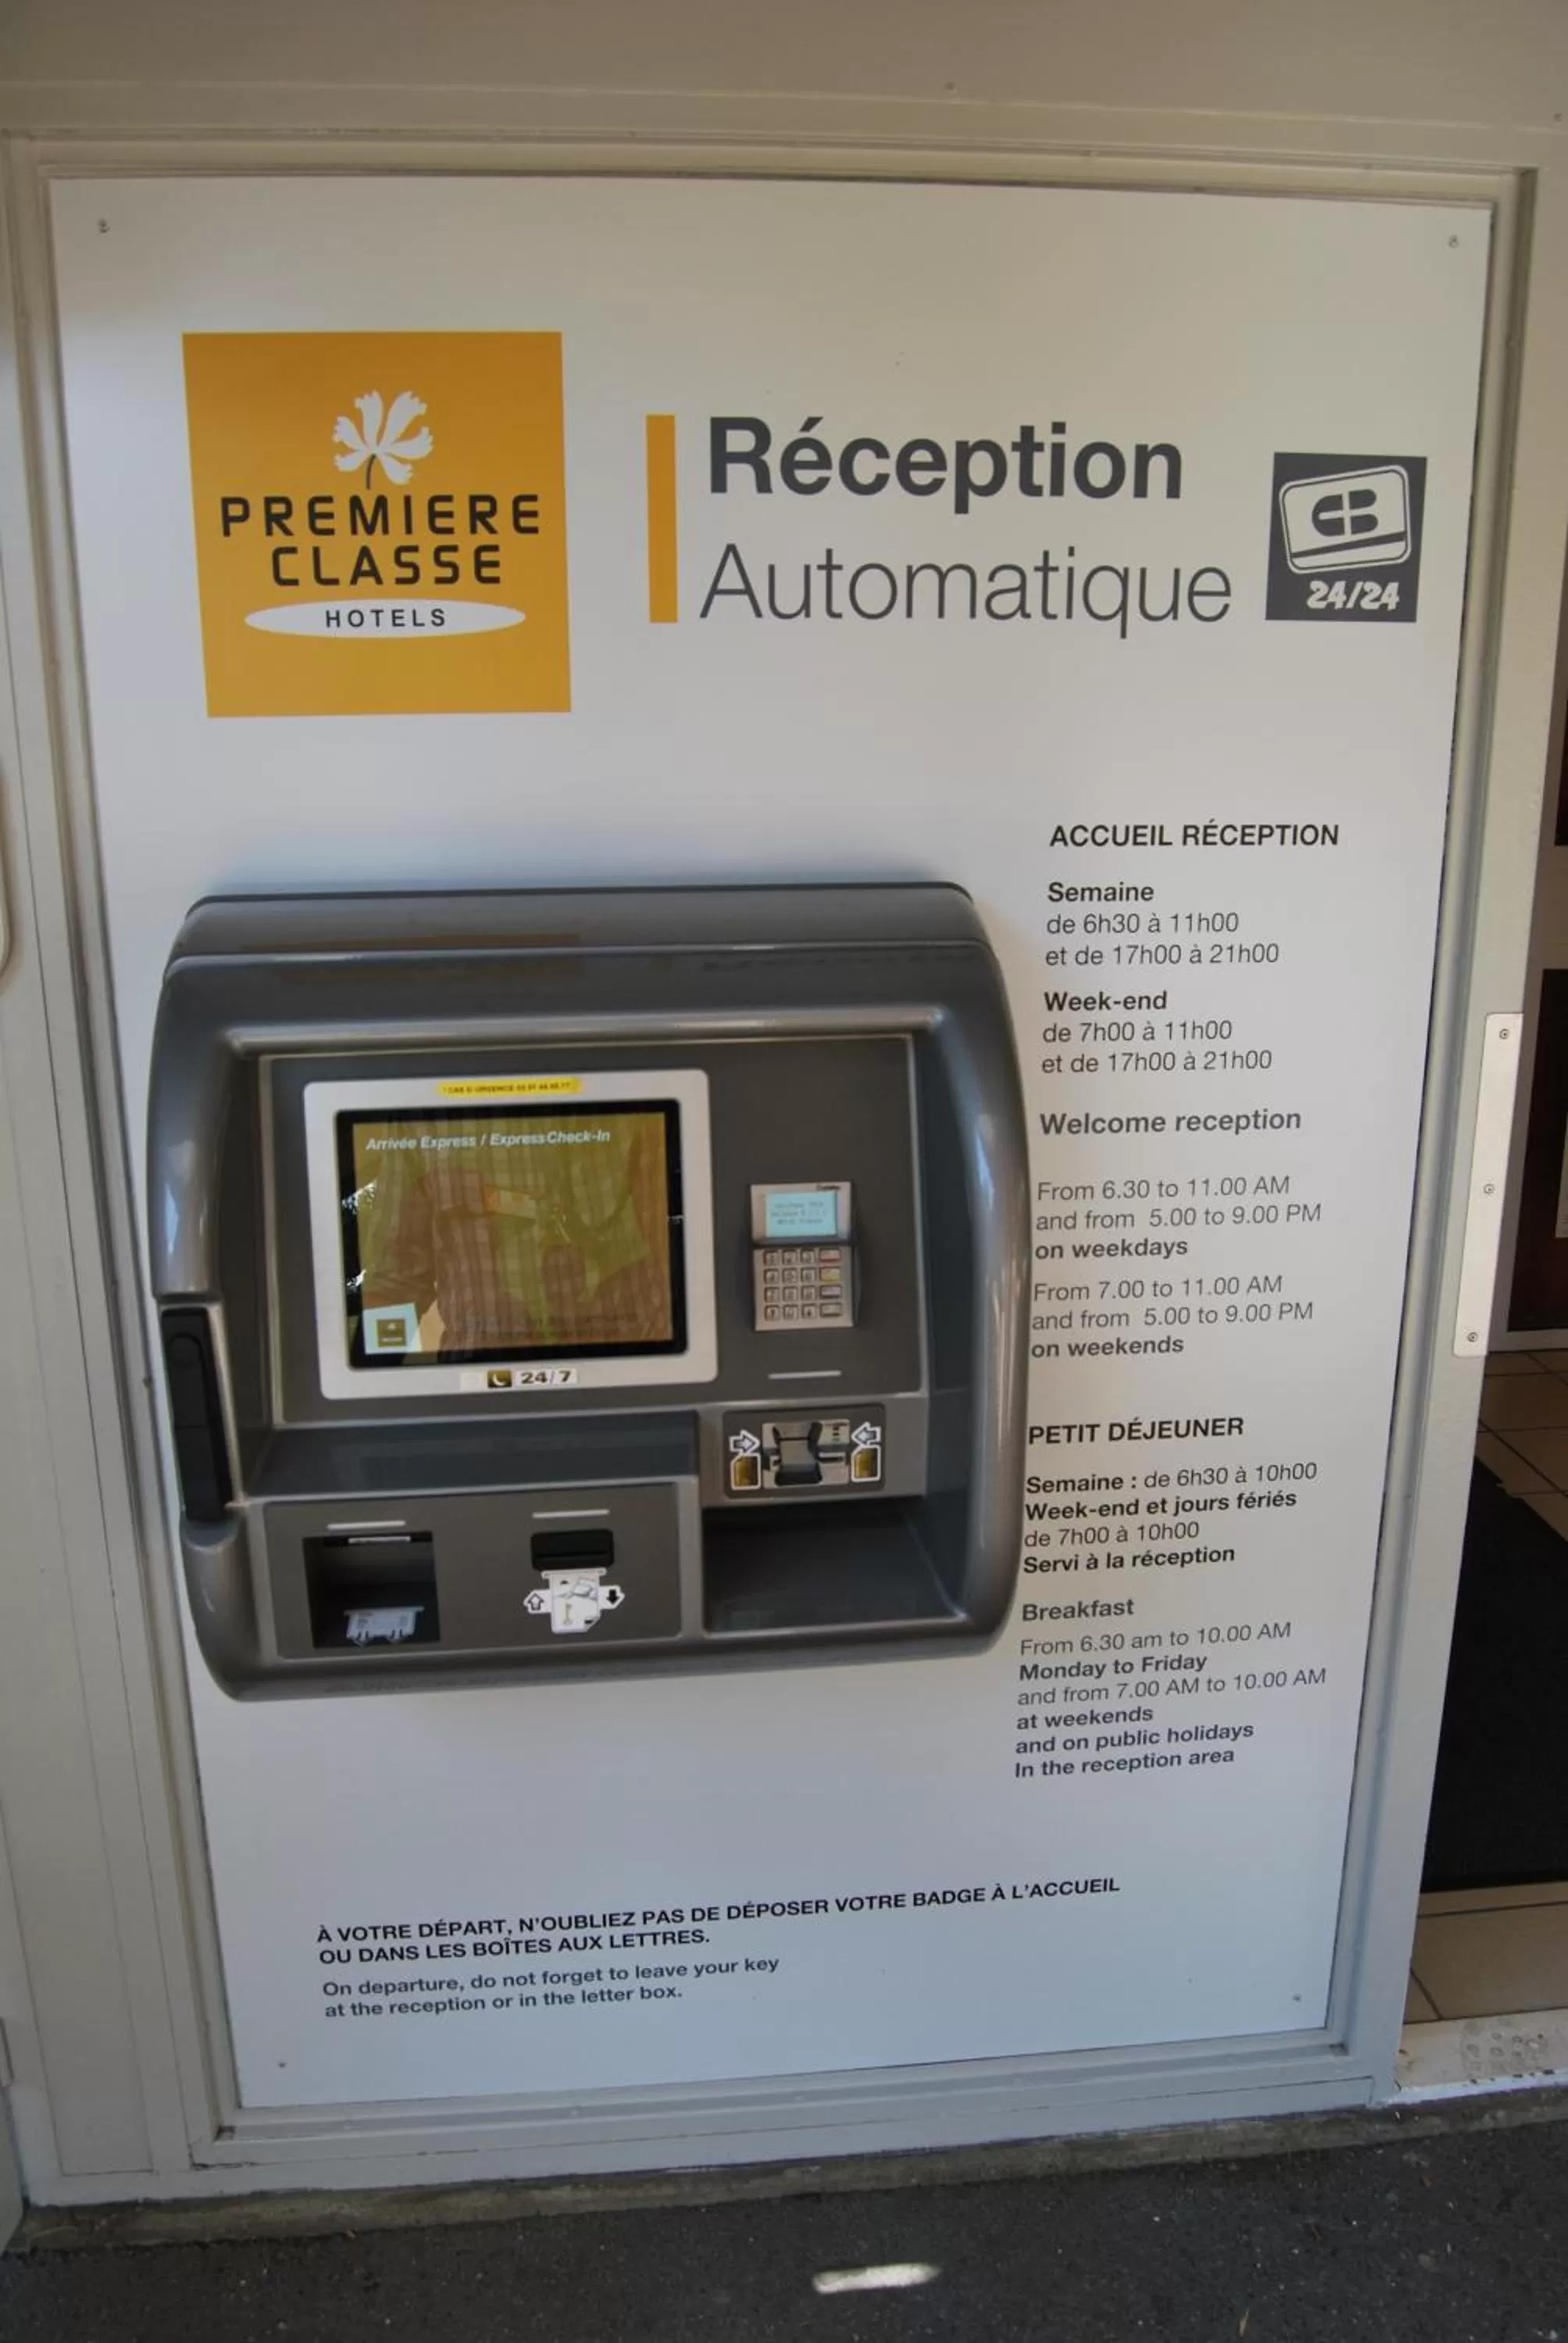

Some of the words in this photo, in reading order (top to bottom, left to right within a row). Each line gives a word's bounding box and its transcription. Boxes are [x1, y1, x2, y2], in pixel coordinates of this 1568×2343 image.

[710, 416, 1183, 514] Réception
[221, 494, 539, 537] PREMIERE
[272, 544, 501, 587] CLASSE
[700, 544, 1232, 639] Automatique
[1306, 580, 1399, 611] 24/24
[326, 608, 446, 628] HOTELS
[1049, 825, 1173, 847] ACCUEIL
[1182, 818, 1338, 846] RÉCEPTION
[1048, 882, 1154, 902] Semaine
[1046, 914, 1075, 934] de
[1083, 914, 1140, 933] 6h30
[1148, 913, 1160, 933] à
[1171, 912, 1238, 933] 11h00
[1046, 947, 1066, 965] et
[1075, 945, 1103, 965] de
[1114, 944, 1181, 965] 17h00
[1189, 944, 1202, 963] à
[1210, 943, 1279, 963] 21h00
[1044, 991, 1167, 1011] Week-end
[1042, 1023, 1071, 1043] de
[1080, 1022, 1135, 1042] 7h00
[1142, 1021, 1155, 1040] à
[1166, 1020, 1232, 1040] 11h00
[1042, 1055, 1062, 1073] et
[1071, 1053, 1099, 1072] de
[1109, 1051, 1176, 1072] 17h00
[1183, 1051, 1196, 1071] à
[1203, 1050, 1272, 1070] 21h00
[1040, 1113, 1166, 1135] Welcome
[1175, 1109, 1301, 1135] reception
[420, 1135, 477, 1150] Express
[1038, 1182, 1094, 1200] From
[1102, 1180, 1149, 1200] 6.30
[1157, 1180, 1178, 1197] to
[1188, 1177, 1246, 1196] 11.00
[1253, 1175, 1290, 1194] AM
[1036, 1211, 1076, 1230] and
[1085, 1211, 1135, 1229] from
[1149, 1207, 1196, 1226] 5.00
[1203, 1207, 1225, 1225] to
[1232, 1205, 1278, 1225] 9.00
[1286, 1203, 1322, 1223] PM
[1035, 1244, 1064, 1260] on
[1072, 1238, 1188, 1260] weekdays
[1034, 1283, 1090, 1302] From
[1099, 1280, 1144, 1300] 7.00
[1152, 1280, 1172, 1297] to
[1182, 1277, 1239, 1296] 11.00
[1246, 1275, 1283, 1294] AM
[1032, 1311, 1072, 1330] and
[1080, 1309, 1129, 1328] from
[1144, 1307, 1191, 1326] 5.00
[1198, 1307, 1218, 1324] to
[1225, 1303, 1270, 1323] 9.00
[1278, 1302, 1313, 1321] PM
[1032, 1343, 1060, 1358] on
[1067, 1336, 1185, 1357] weekends
[1028, 1424, 1100, 1445] PETIT
[1108, 1418, 1245, 1441] DÉJEUNER
[1026, 1474, 1124, 1494] Semaine
[1144, 1472, 1171, 1489] de
[1177, 1467, 1228, 1488] 6h30
[1235, 1465, 1248, 1483] à
[1256, 1462, 1317, 1481] 10h00
[1025, 1499, 1139, 1521] Week-end
[1146, 1497, 1168, 1515] et
[1174, 1493, 1230, 1517] jours
[1237, 1490, 1297, 1510] fériés
[1025, 1530, 1050, 1548] de
[1059, 1527, 1110, 1546] 7h00
[1116, 1525, 1128, 1543] à
[1138, 1521, 1199, 1541] 10h00
[1024, 1554, 1079, 1574] Servi
[1086, 1551, 1099, 1570] à
[1106, 1551, 1125, 1569] la
[1132, 1546, 1235, 1568] réception
[1022, 1599, 1135, 1622] Breakfast
[1021, 1638, 1074, 1656] From
[1080, 1633, 1125, 1653] 6.30
[1131, 1635, 1163, 1649] am
[1170, 1630, 1189, 1646] to
[1197, 1625, 1251, 1643] 10.00
[1257, 1621, 1292, 1639] AM
[1019, 1660, 1107, 1681] Monday
[1114, 1657, 1135, 1675] to
[1142, 1653, 1208, 1674] Friday
[1017, 1687, 1056, 1706] and
[1063, 1684, 1109, 1702] from
[1117, 1680, 1160, 1699] 7.00
[1165, 1677, 1199, 1695] AM
[1206, 1675, 1225, 1692] to
[1234, 1671, 1287, 1690] 10.00
[1293, 1667, 1326, 1685] AM
[1017, 1713, 1038, 1730] at
[1044, 1706, 1153, 1728] weekends
[1015, 1736, 1055, 1754] and
[1063, 1737, 1089, 1751] on
[1096, 1729, 1160, 1752] public
[1167, 1723, 1255, 1744] holidays
[1015, 1762, 1034, 1778] In
[1042, 1759, 1075, 1776] the
[1082, 1753, 1181, 1773] reception
[1188, 1749, 1235, 1764] area
[317, 1925, 332, 1943] À
[337, 1924, 412, 1942] VOTRE
[419, 1918, 512, 1938] DÉPART,
[519, 1912, 636, 1932] N'OUBLIEZ
[643, 1909, 685, 1925] PAS
[691, 1906, 720, 1922] DE
[727, 1900, 829, 1920] DÉPOSER
[836, 1894, 907, 1912] VOTRE
[914, 1888, 986, 1906] BADGE
[991, 1883, 1006, 1900] À
[1012, 1878, 1120, 1899] L'ACCUEIL
[319, 1949, 351, 1964] OU
[358, 1945, 419, 1963] DANS
[426, 1943, 466, 1960] LES
[473, 1938, 551, 1956] BOÎTES
[558, 1935, 603, 1952] AUX
[610, 1929, 710, 1949] LETTRES.
[323, 1981, 351, 1996] On
[358, 1977, 465, 1996] departure,
[470, 1974, 497, 1988] do
[502, 1972, 536, 1988] not
[542, 1967, 603, 1987] forget
[610, 1967, 629, 1980] to
[636, 1964, 688, 1979] leave
[693, 1961, 739, 1978] your
[744, 1958, 779, 1973] key
[325, 2003, 344, 2017] at
[351, 2001, 383, 2016] the
[390, 1996, 486, 2015] reception
[492, 1996, 513, 2010] or
[519, 1993, 537, 2007] in
[543, 1991, 575, 2006] the
[582, 1988, 634, 2005] letter
[640, 1986, 682, 1999] box.
